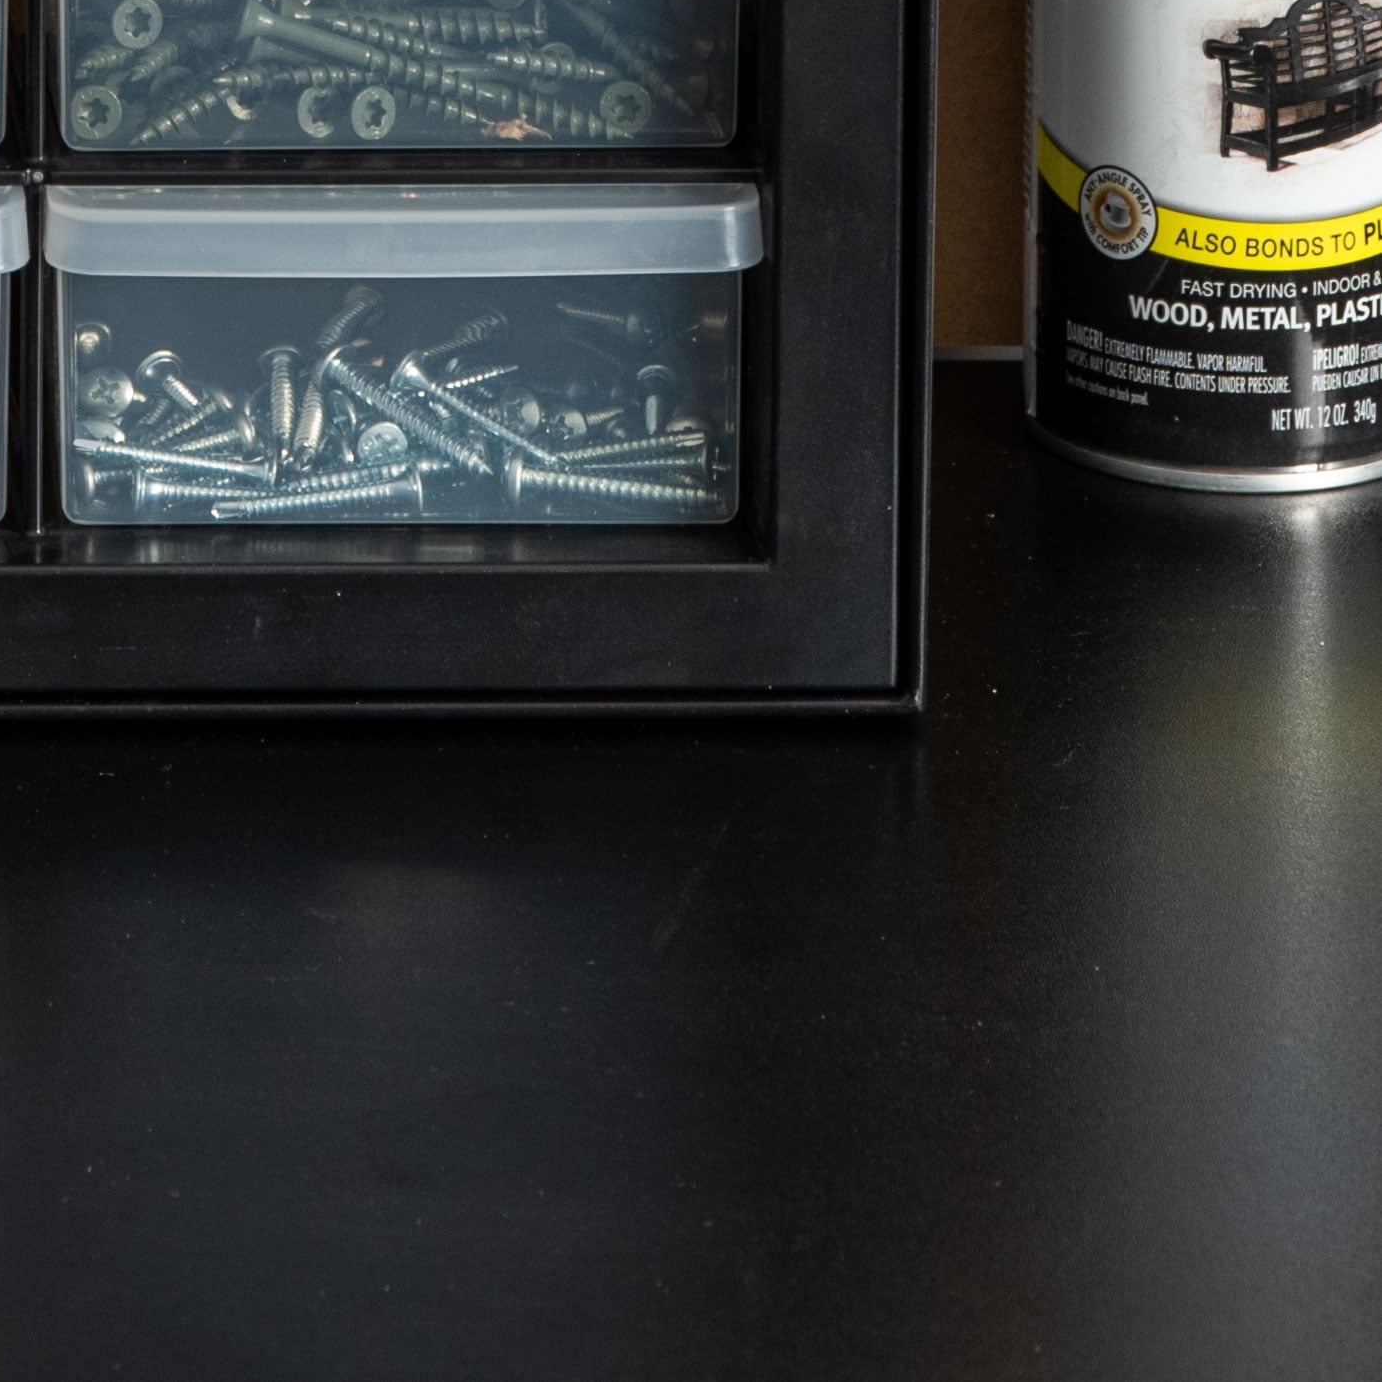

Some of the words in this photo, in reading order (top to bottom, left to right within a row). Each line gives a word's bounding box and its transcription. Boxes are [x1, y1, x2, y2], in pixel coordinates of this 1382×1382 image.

[1128, 182, 1153, 218] SPRAY
[1096, 234, 1140, 255] COMFORT
[1137, 226, 1150, 243] TIP
[1174, 227, 1237, 256] ALSO
[1245, 235, 1324, 258] BONDS
[1331, 231, 1356, 253] TO
[1181, 279, 1225, 298] FAST
[1229, 282, 1297, 299] DRYING
[1313, 273, 1371, 296] INDOOR
[1372, 270, 1382, 286] &
[1129, 294, 1215, 333] WOOD,
[1220, 305, 1311, 333] METAL,
[1065, 319, 1104, 353] DANGER!
[1104, 336, 1146, 362] EXTREMELY
[1146, 345, 1196, 369] FLAMMABLE.
[1196, 352, 1225, 372] VAPOR
[1225, 354, 1268, 374] HARMFUL.
[1104, 357, 1128, 380] CAUSE
[1128, 363, 1153, 385] FLASH
[1174, 371, 1217, 393] CONTENTS
[1217, 374, 1246, 394] UNDER
[1247, 375, 1292, 395] PRESSURE.
[1312, 371, 1342, 392] PUEDEN
[1342, 367, 1369, 387] CAUSAR
[1271, 408, 1292, 431] NET
[1294, 406, 1314, 430] WT.
[1317, 404, 1331, 428] 12
[1332, 403, 1350, 426] OZ.
[1353, 397, 1377, 424] 340g
